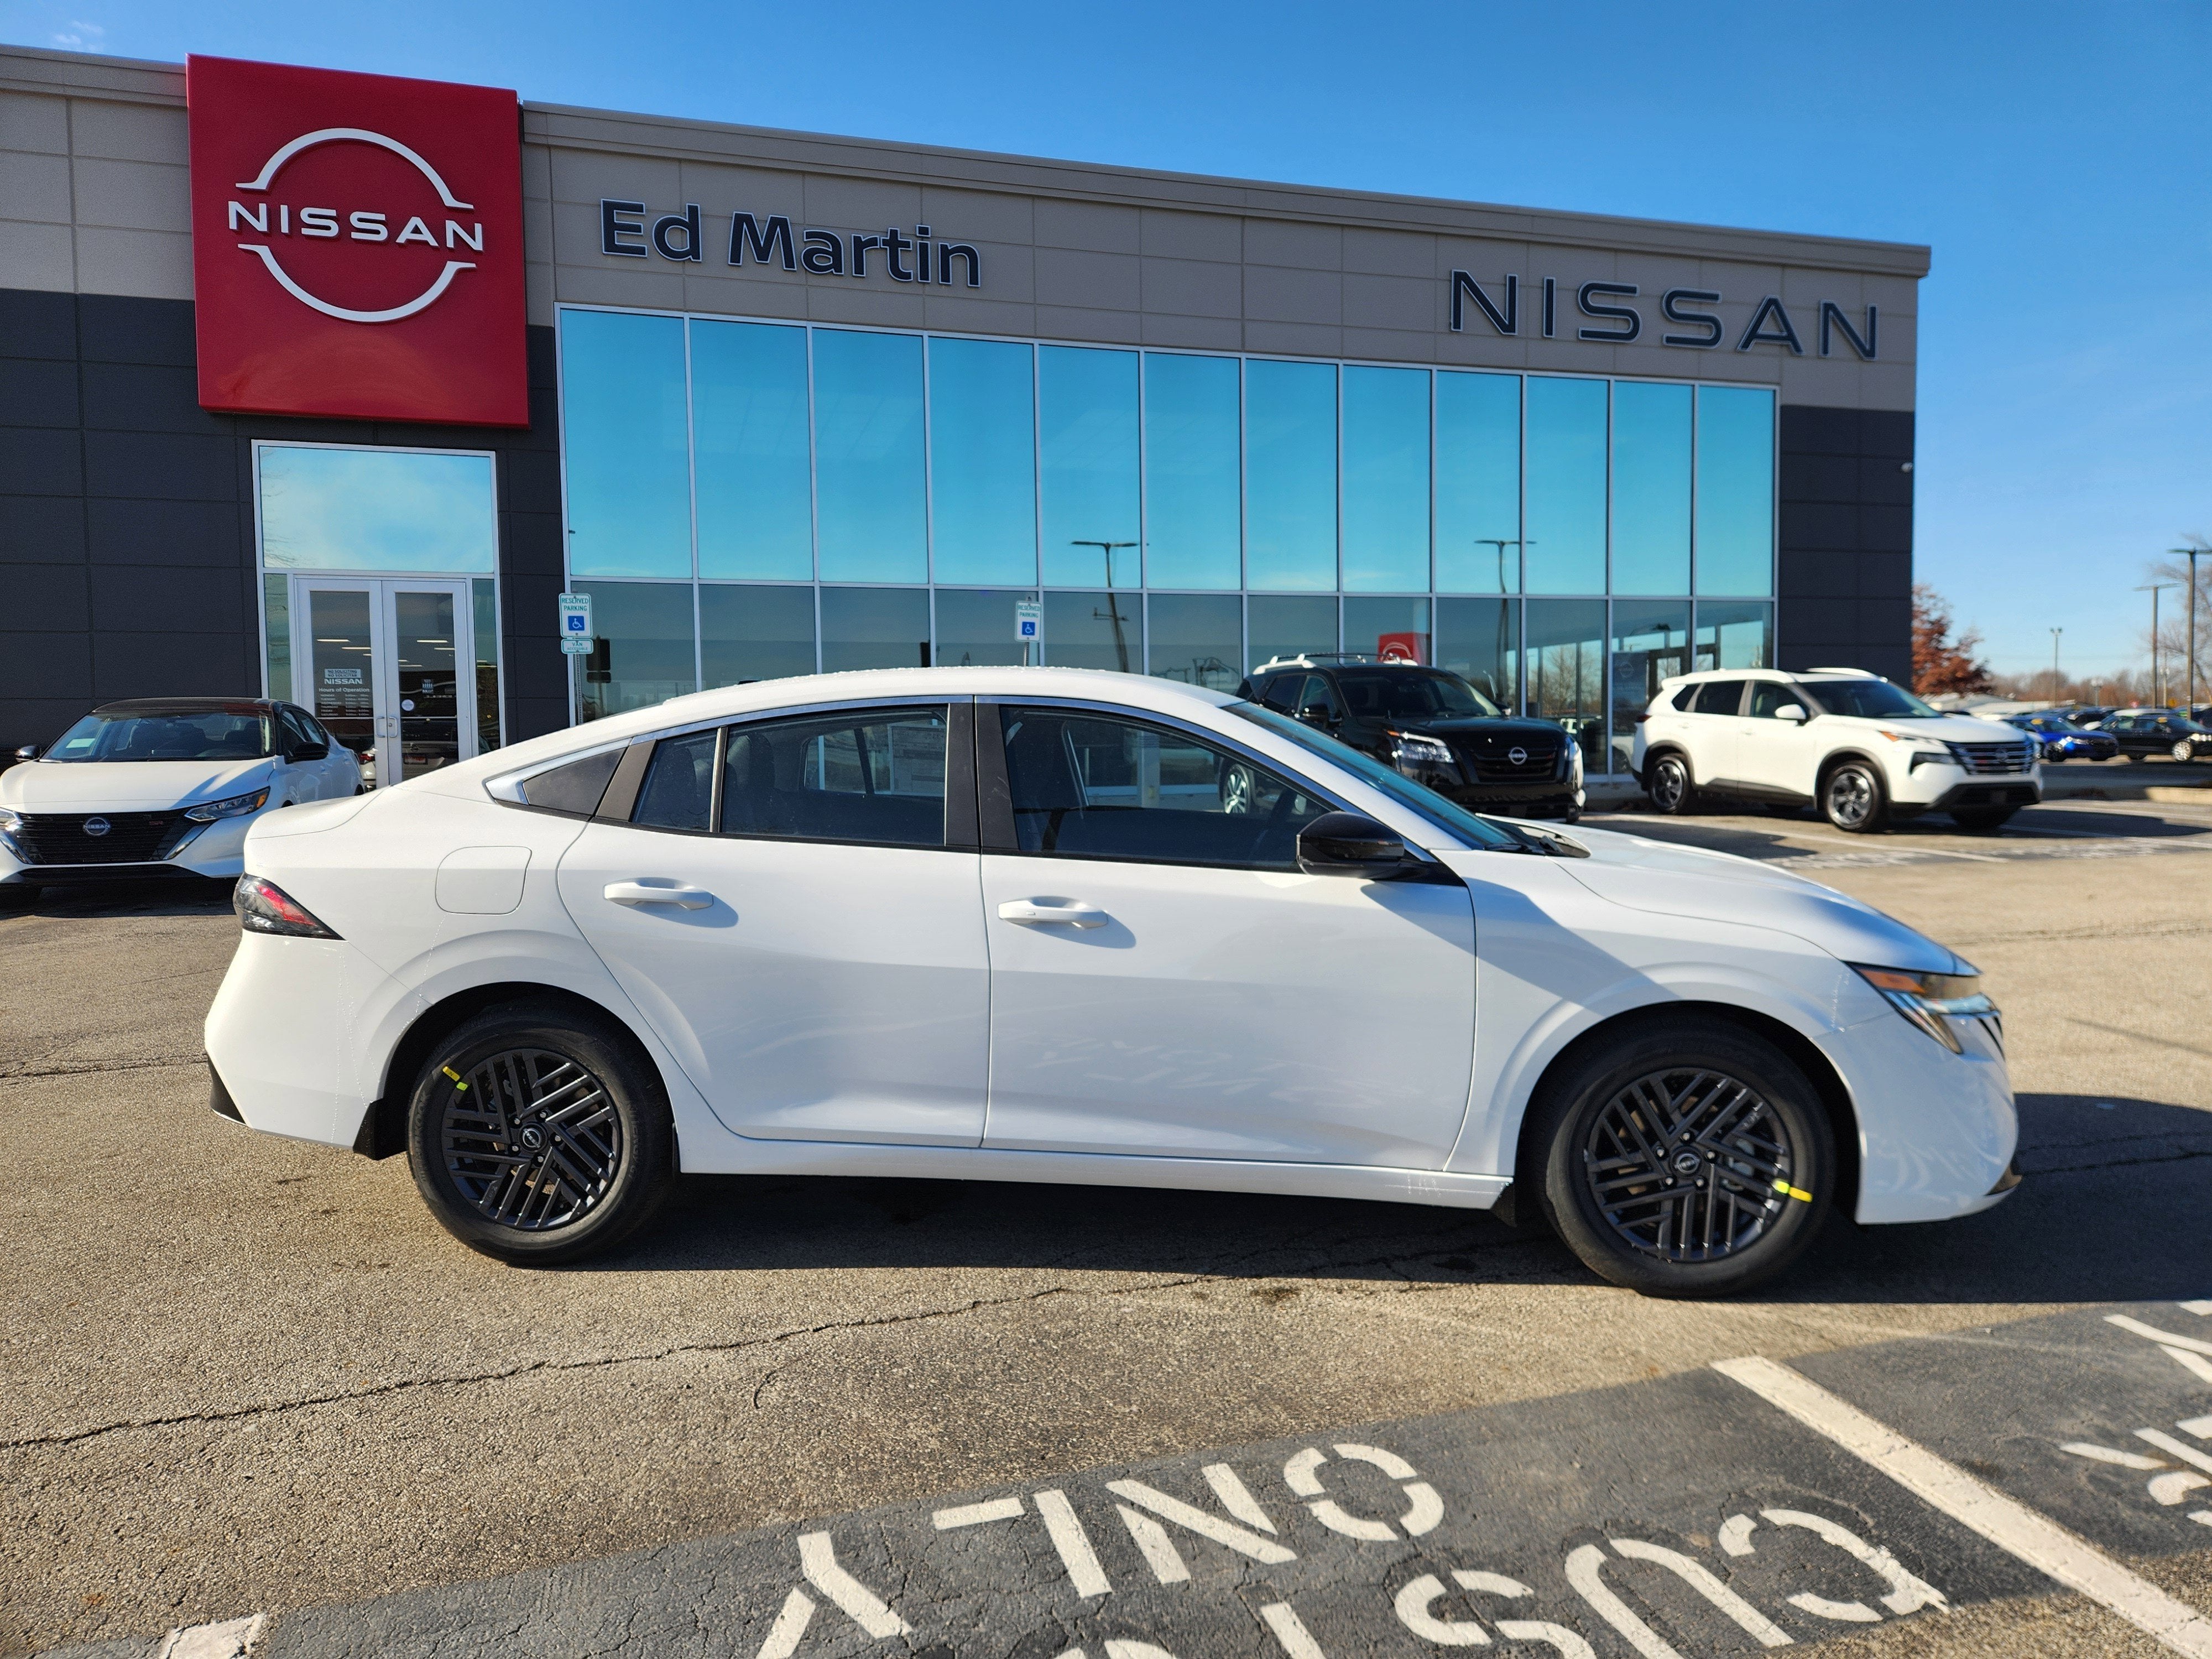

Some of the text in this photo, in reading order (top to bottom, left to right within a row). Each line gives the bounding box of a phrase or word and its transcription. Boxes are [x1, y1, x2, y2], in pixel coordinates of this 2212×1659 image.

[228, 201, 483, 252] NISSAN
[601, 199, 982, 288] Ed Martin
[1449, 269, 1878, 361] NISSAN
[757, 1443, 1444, 1659] ONLY
